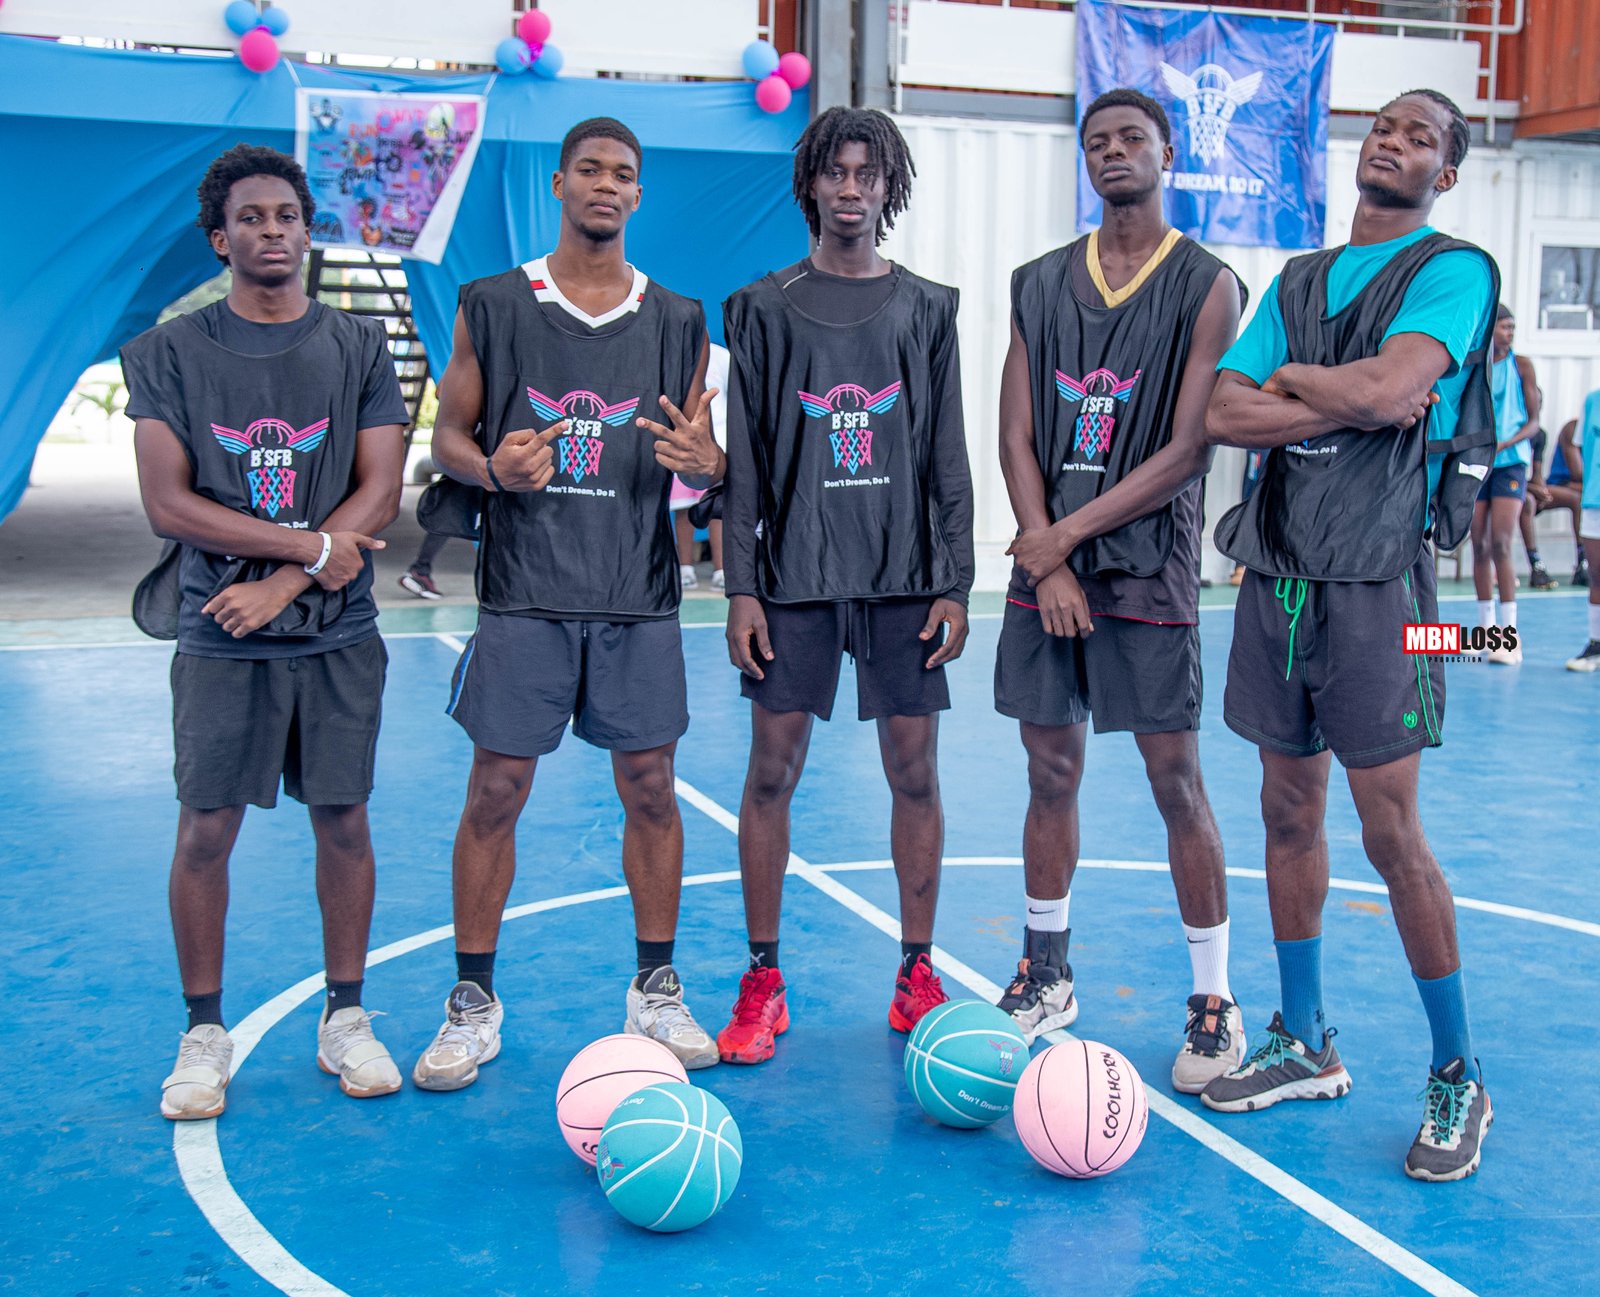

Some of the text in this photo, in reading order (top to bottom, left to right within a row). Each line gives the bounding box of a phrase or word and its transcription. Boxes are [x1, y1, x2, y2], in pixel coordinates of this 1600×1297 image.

[1185, 93, 1237, 122] B'SFB
[831, 410, 869, 430] B'SFB
[250, 447, 293, 467] B'SFB
[546, 485, 616, 498] Don't Dream, Do It
[824, 476, 890, 488] Don't Dream, Do It
[957, 1089, 980, 1105] Don't
[1100, 1051, 1121, 1139] COOLHORN
